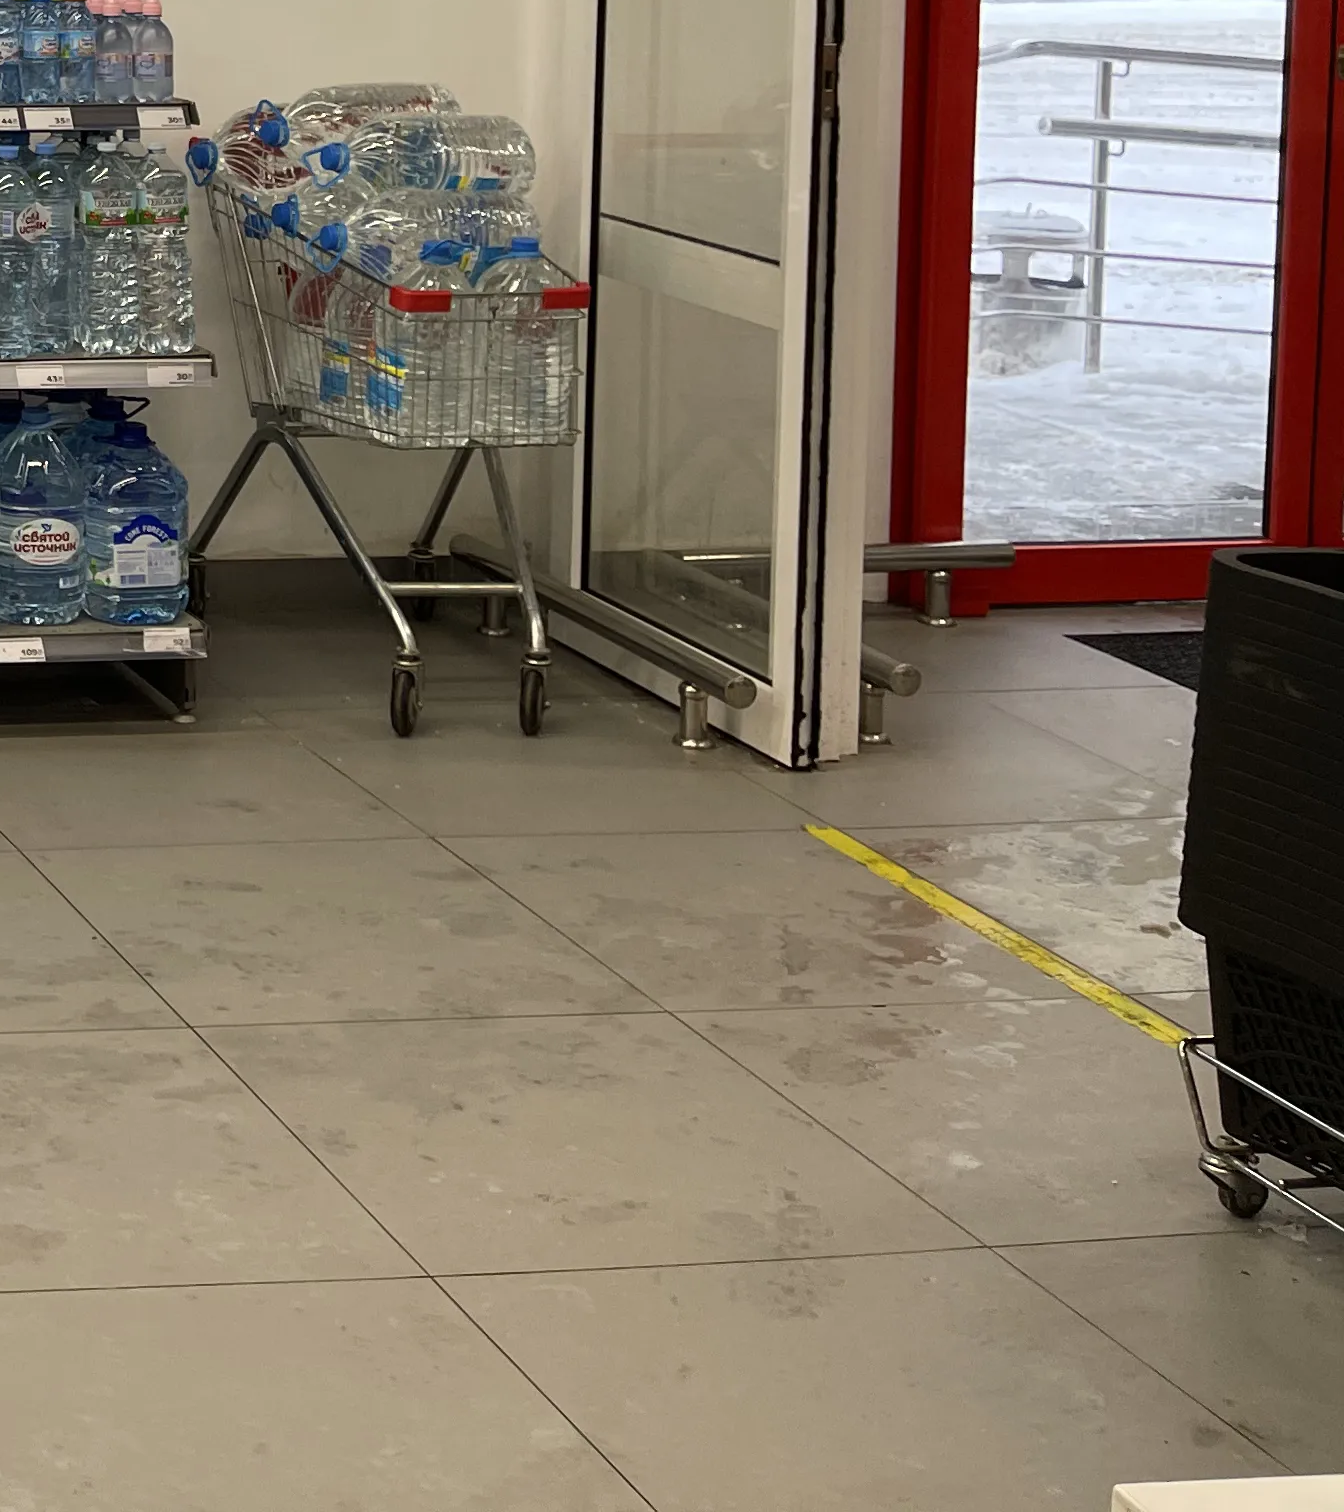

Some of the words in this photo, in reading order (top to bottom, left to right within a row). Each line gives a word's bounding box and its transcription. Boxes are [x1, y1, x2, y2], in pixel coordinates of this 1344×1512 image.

[22, 533, 70, 544] святой
[142, 525, 168, 541] FOREST
[14, 542, 76, 553] источник
